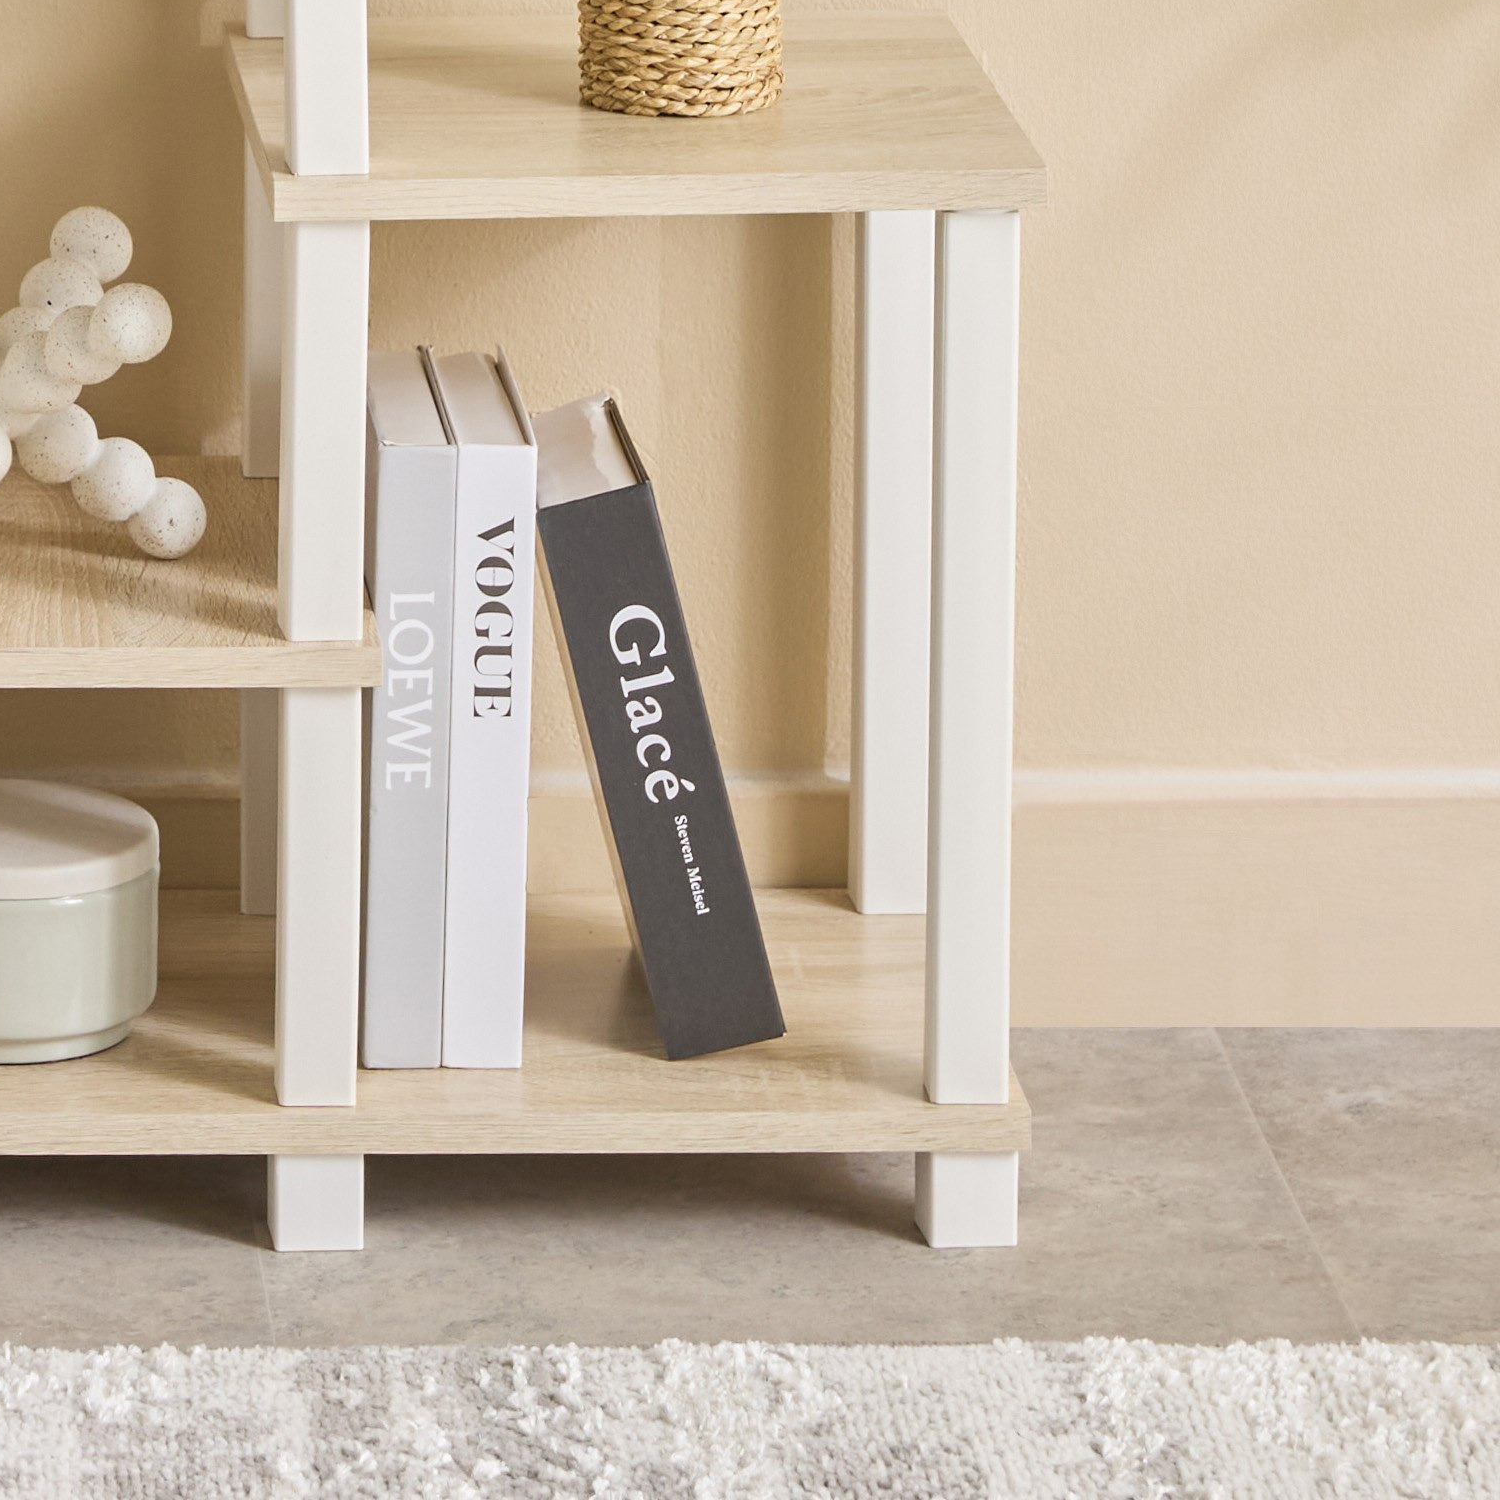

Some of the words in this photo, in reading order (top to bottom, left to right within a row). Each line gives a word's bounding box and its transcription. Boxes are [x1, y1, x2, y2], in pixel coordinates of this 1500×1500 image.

[385, 590, 436, 790] LOEWE
[474, 516, 515, 717] VOGUE
[609, 604, 696, 804] Glacé
[675, 815, 694, 863] Steven
[687, 867, 710, 915] Meisel
